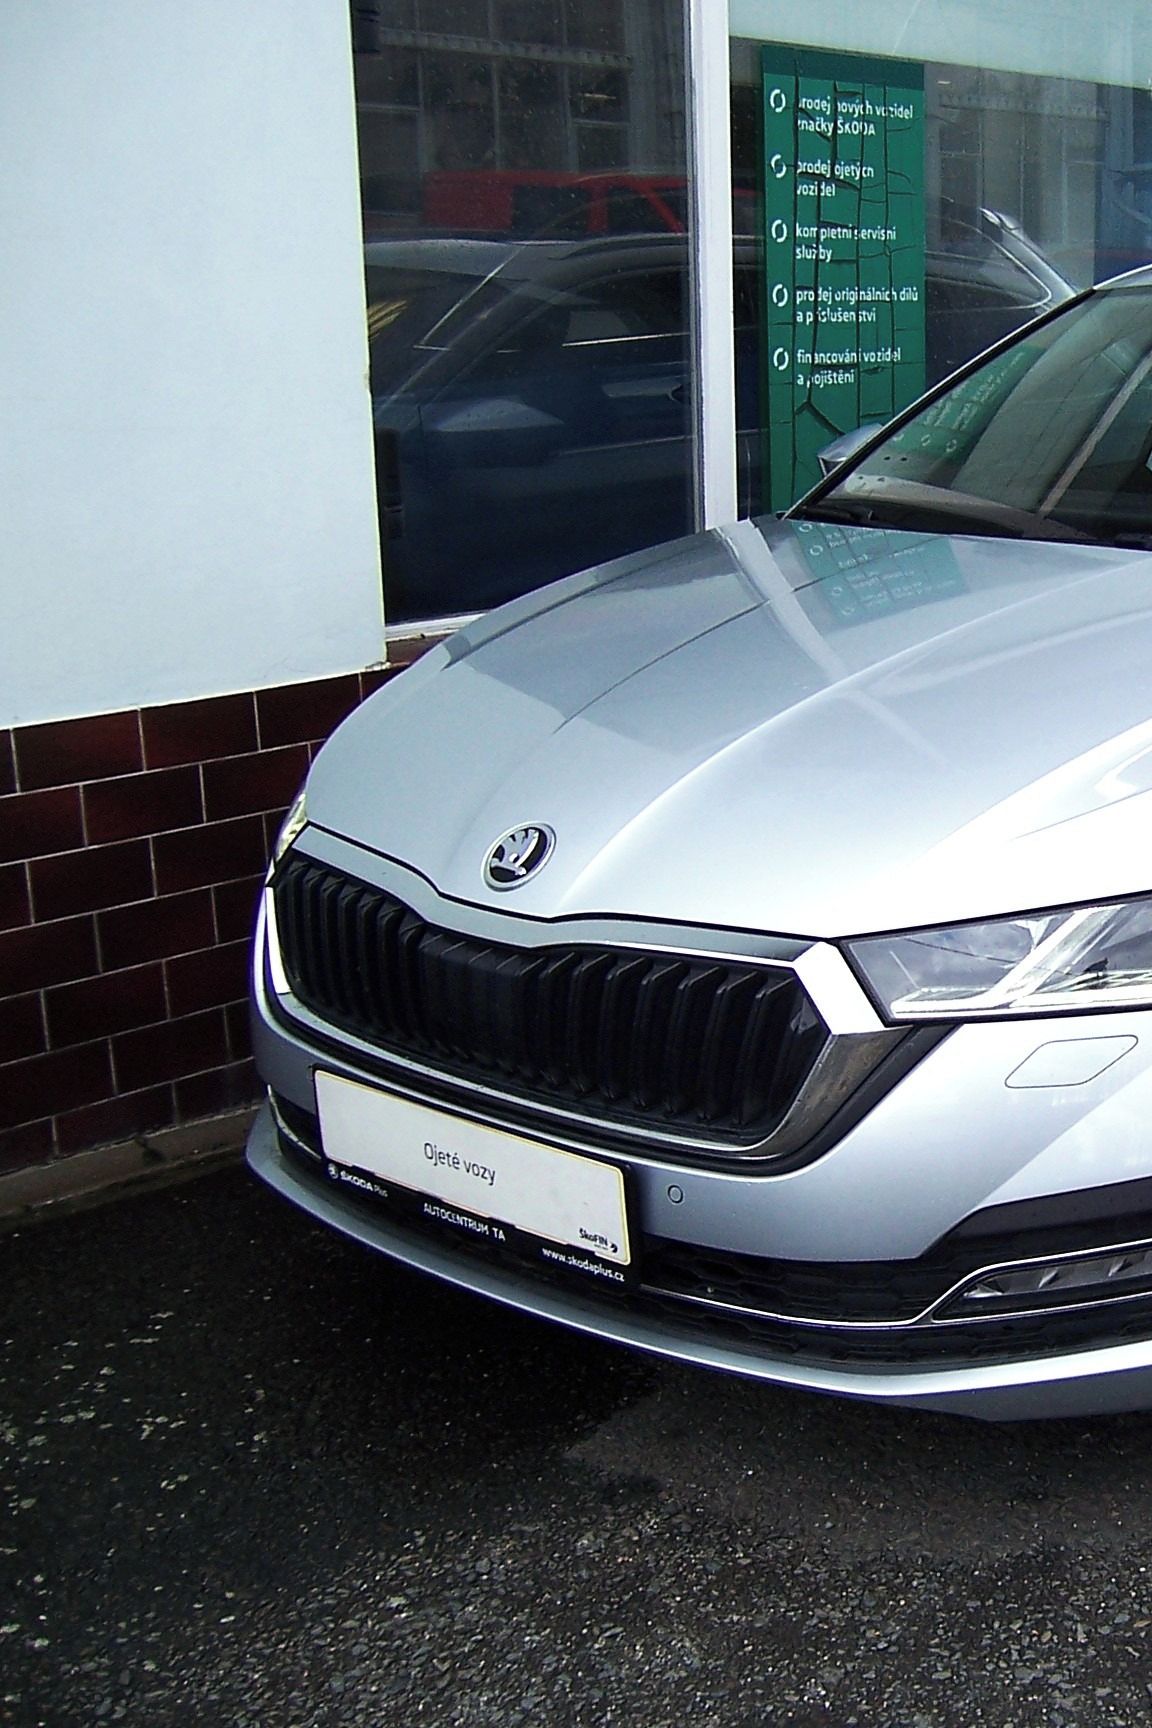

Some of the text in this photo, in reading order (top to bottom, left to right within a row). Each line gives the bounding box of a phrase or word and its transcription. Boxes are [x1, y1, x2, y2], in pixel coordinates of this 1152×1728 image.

[796, 307, 876, 325] a píslušenství
[863, 347, 901, 362] vozidel
[797, 373, 804, 385] a
[424, 1142, 496, 1186] Ojeté vozy
[541, 1246, 625, 1282] www.skodaplus.cz
